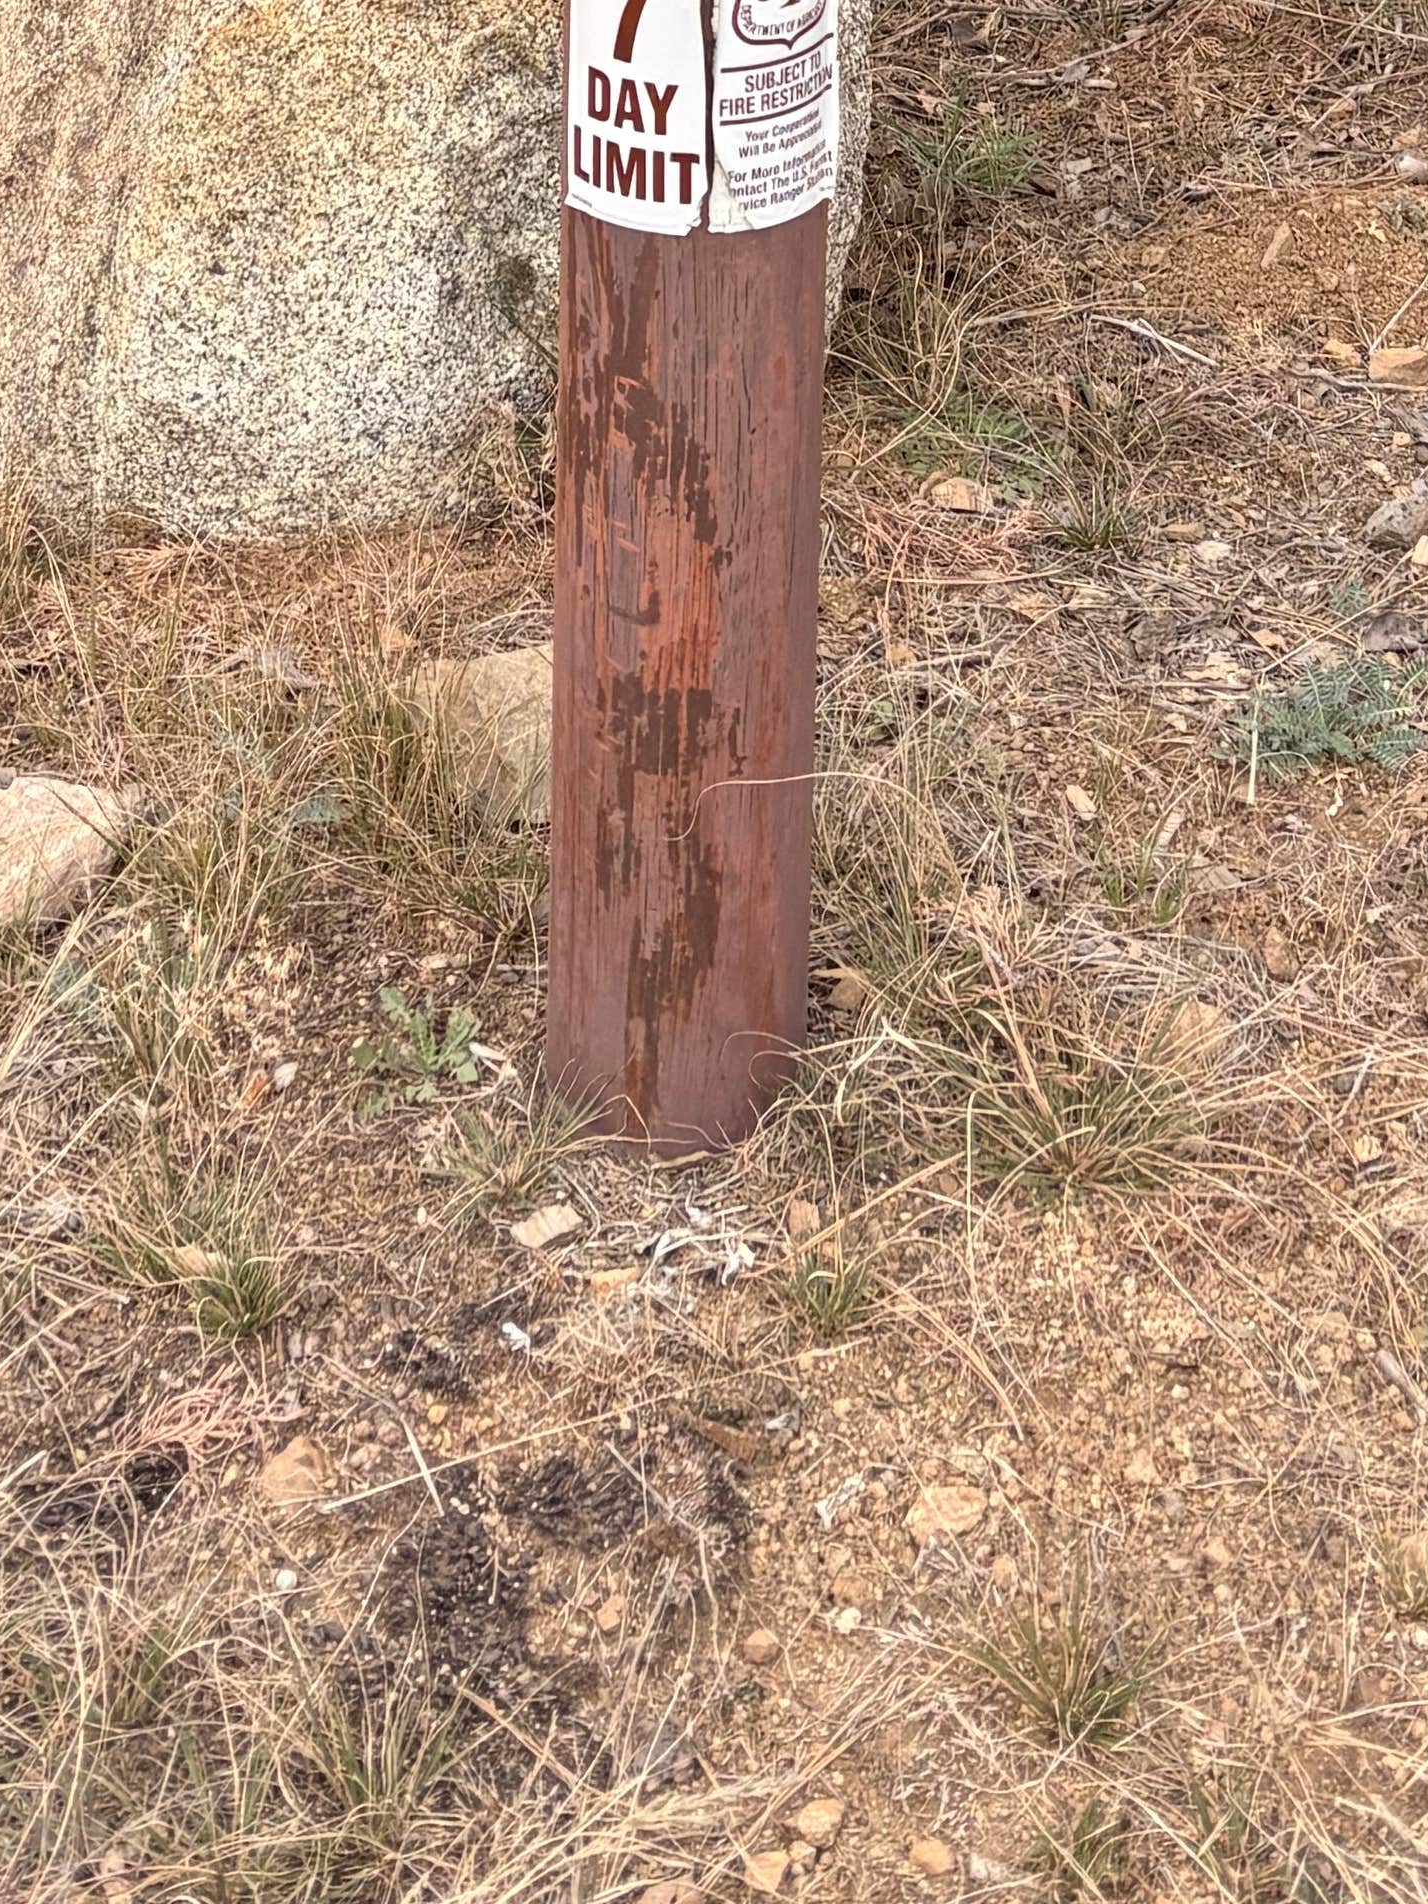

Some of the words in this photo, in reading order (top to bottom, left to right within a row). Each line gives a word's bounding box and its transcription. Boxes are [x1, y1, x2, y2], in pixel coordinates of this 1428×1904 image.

[745, 59, 807, 93] SUBJECT
[808, 50, 821, 73] TO
[586, 65, 678, 136] DAY
[719, 96, 755, 117] FIRE
[745, 130, 769, 143] Your
[739, 144, 759, 159] Will
[763, 142, 776, 154] Be
[573, 124, 701, 206] LIMIT
[728, 170, 747, 184] For
[752, 165, 780, 181] More
[772, 176, 790, 191] The
